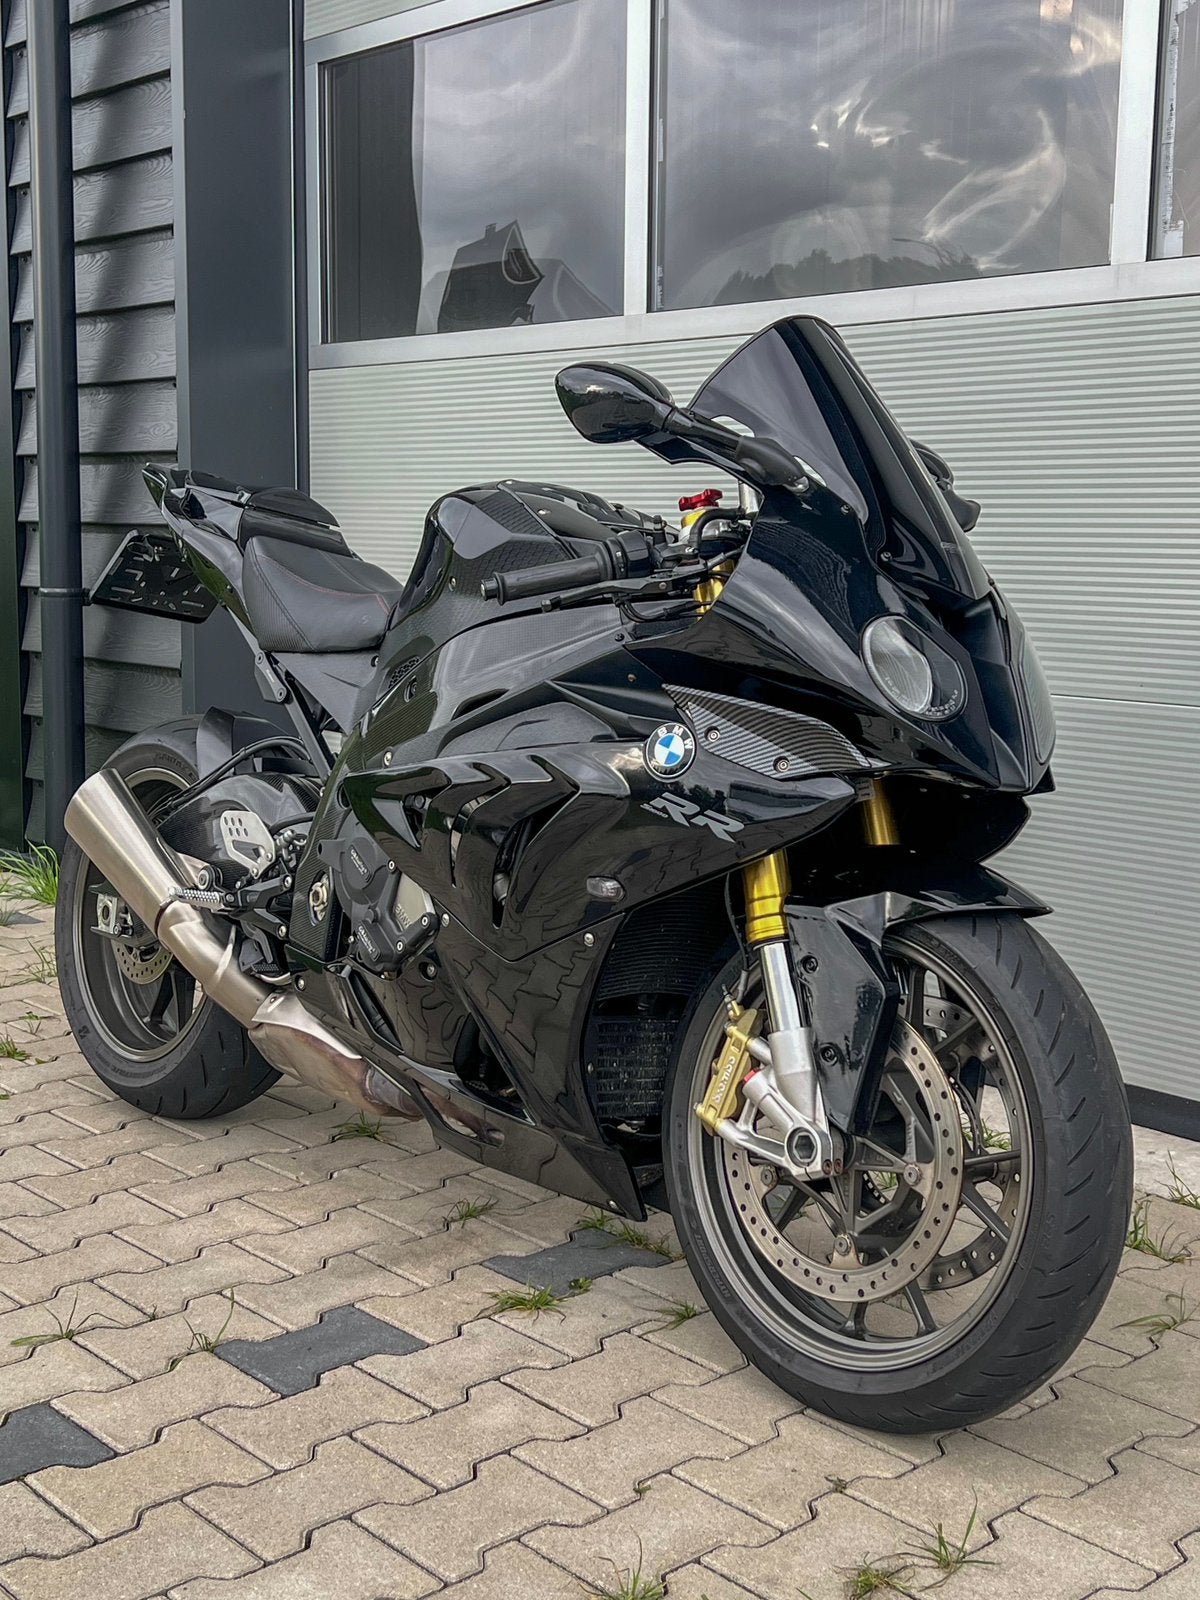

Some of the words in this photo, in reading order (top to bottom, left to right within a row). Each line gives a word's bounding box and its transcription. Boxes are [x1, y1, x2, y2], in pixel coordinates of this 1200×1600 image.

[657, 725, 693, 749] BMW
[649, 792, 745, 843] RR
[395, 904, 413, 929] BMW
[714, 1055, 736, 1104] brembo
[694, 1234, 732, 1299] HYPERSPORT
